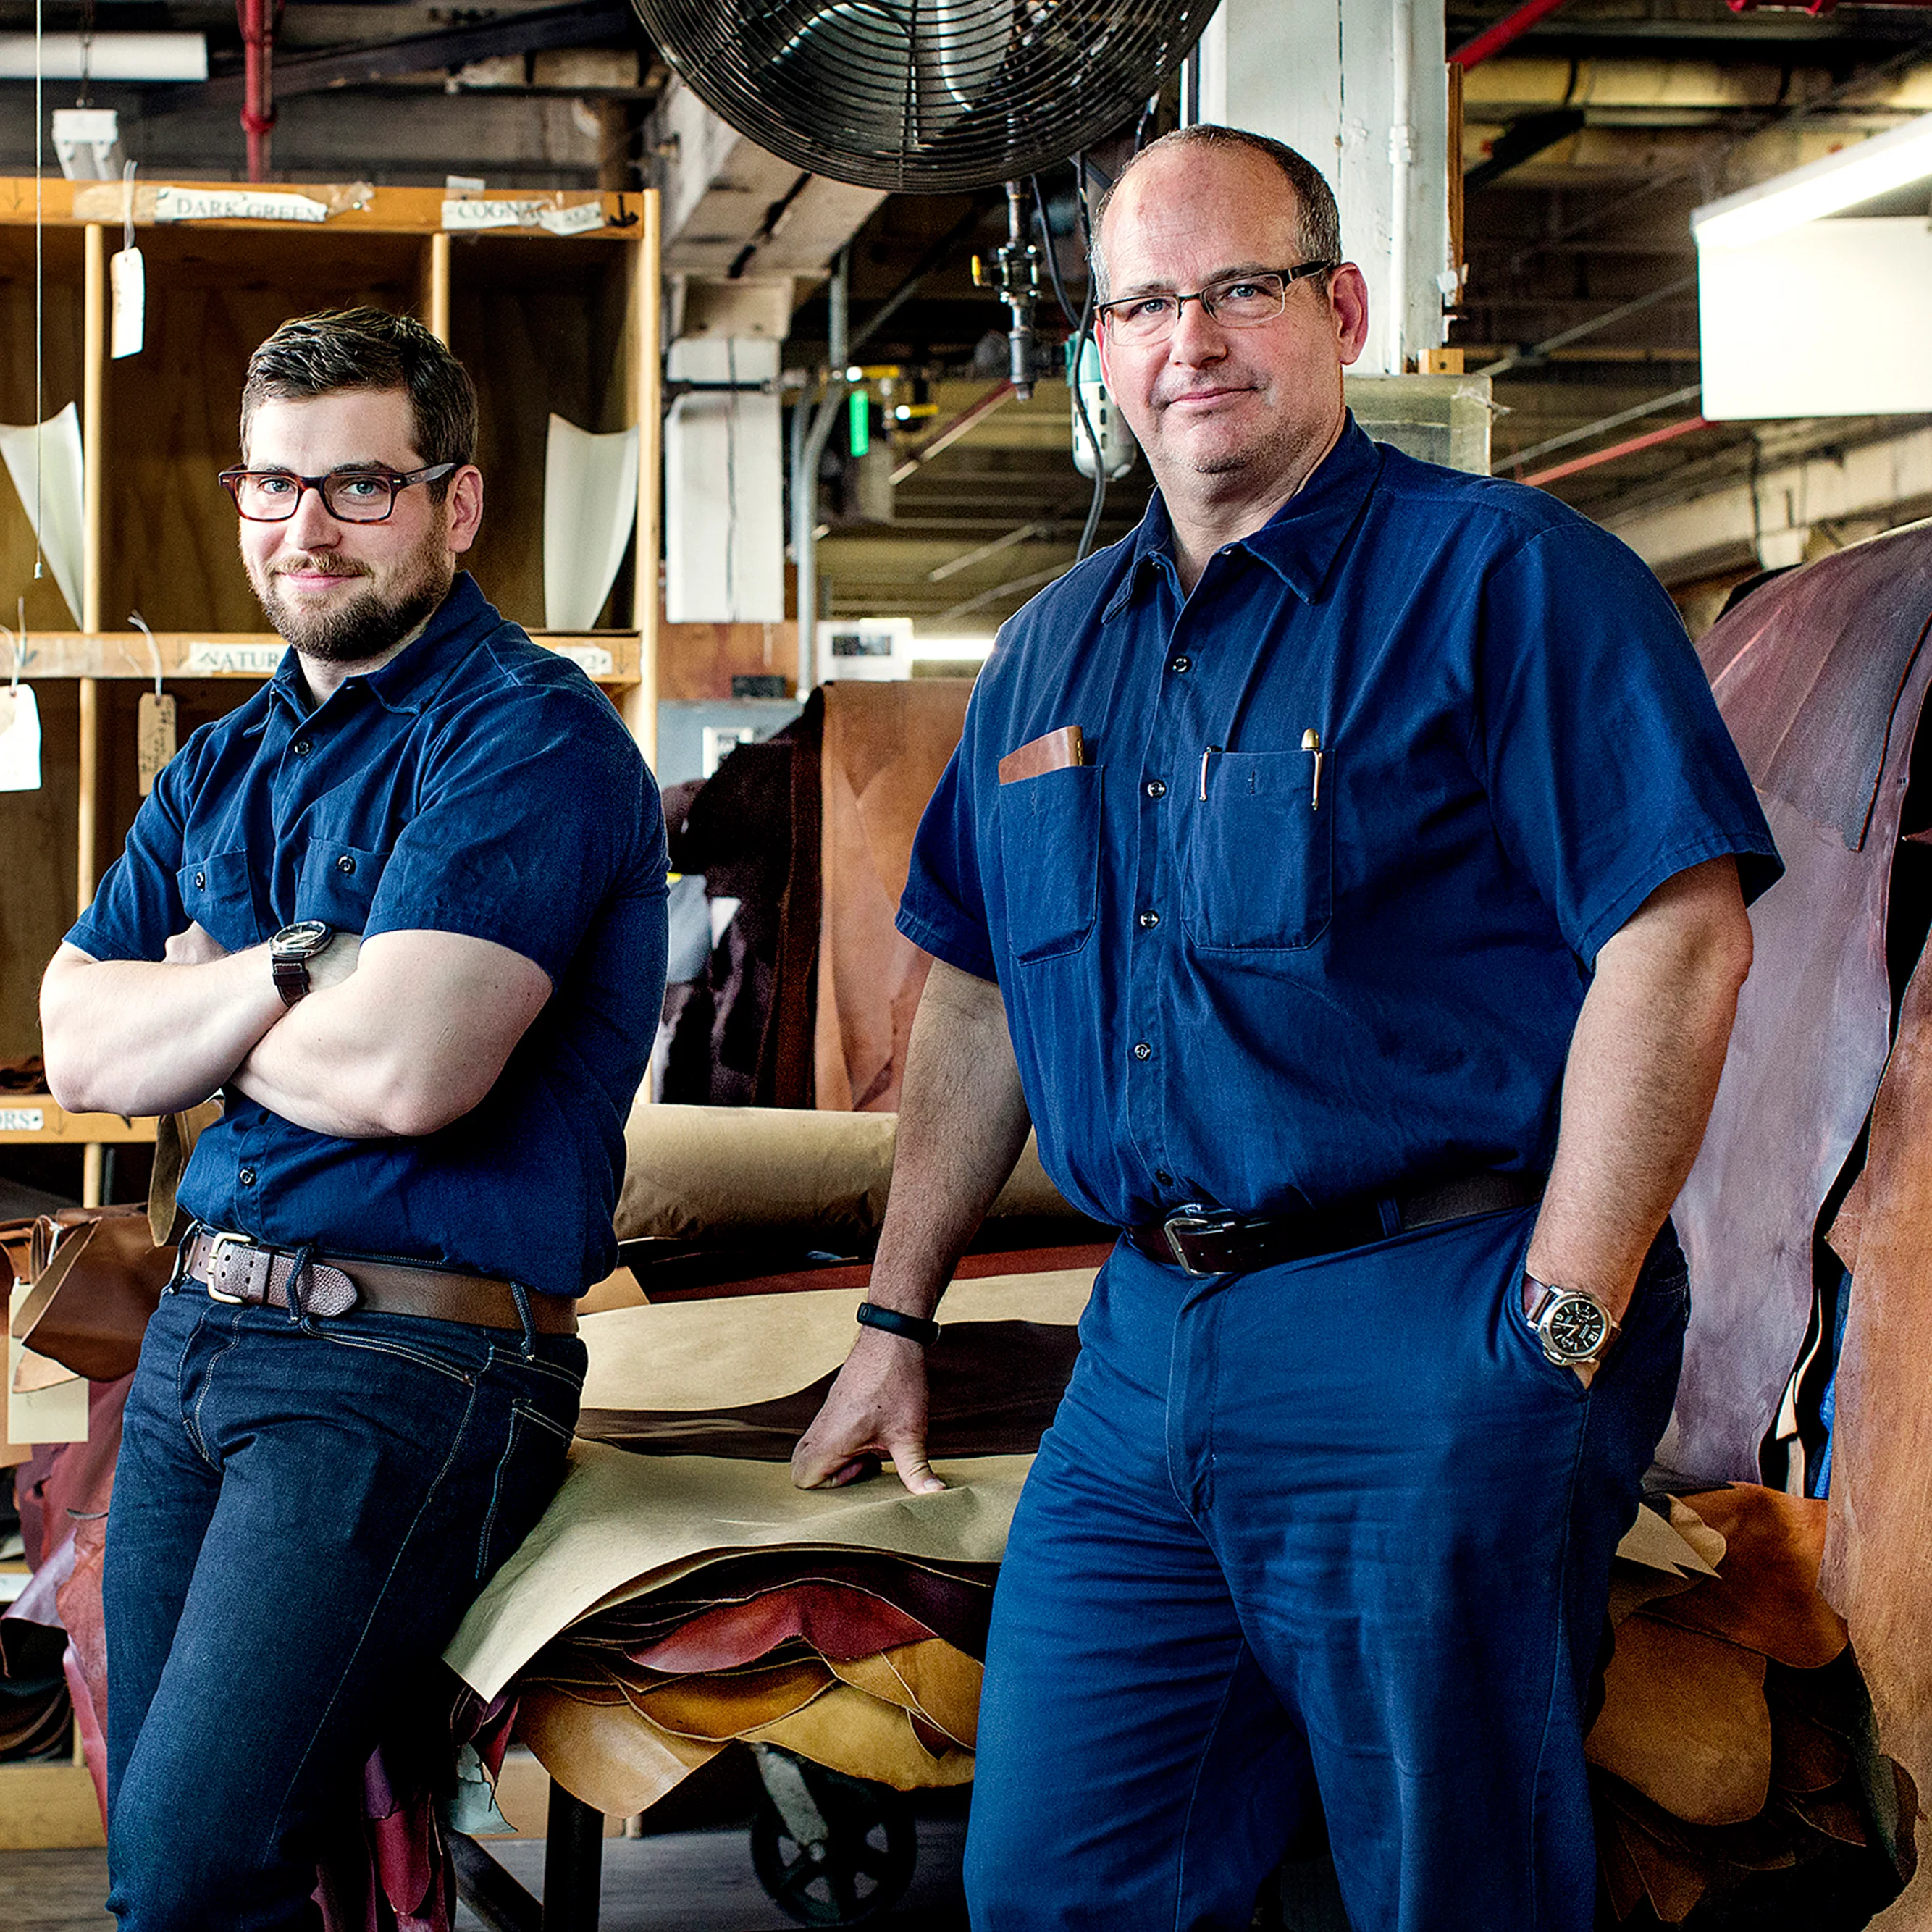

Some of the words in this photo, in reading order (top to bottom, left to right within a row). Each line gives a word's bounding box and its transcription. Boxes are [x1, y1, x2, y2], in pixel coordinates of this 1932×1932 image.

[176, 196, 239, 217] DARK
[245, 203, 324, 222] GREEN
[0, 1111, 30, 1130] RS
